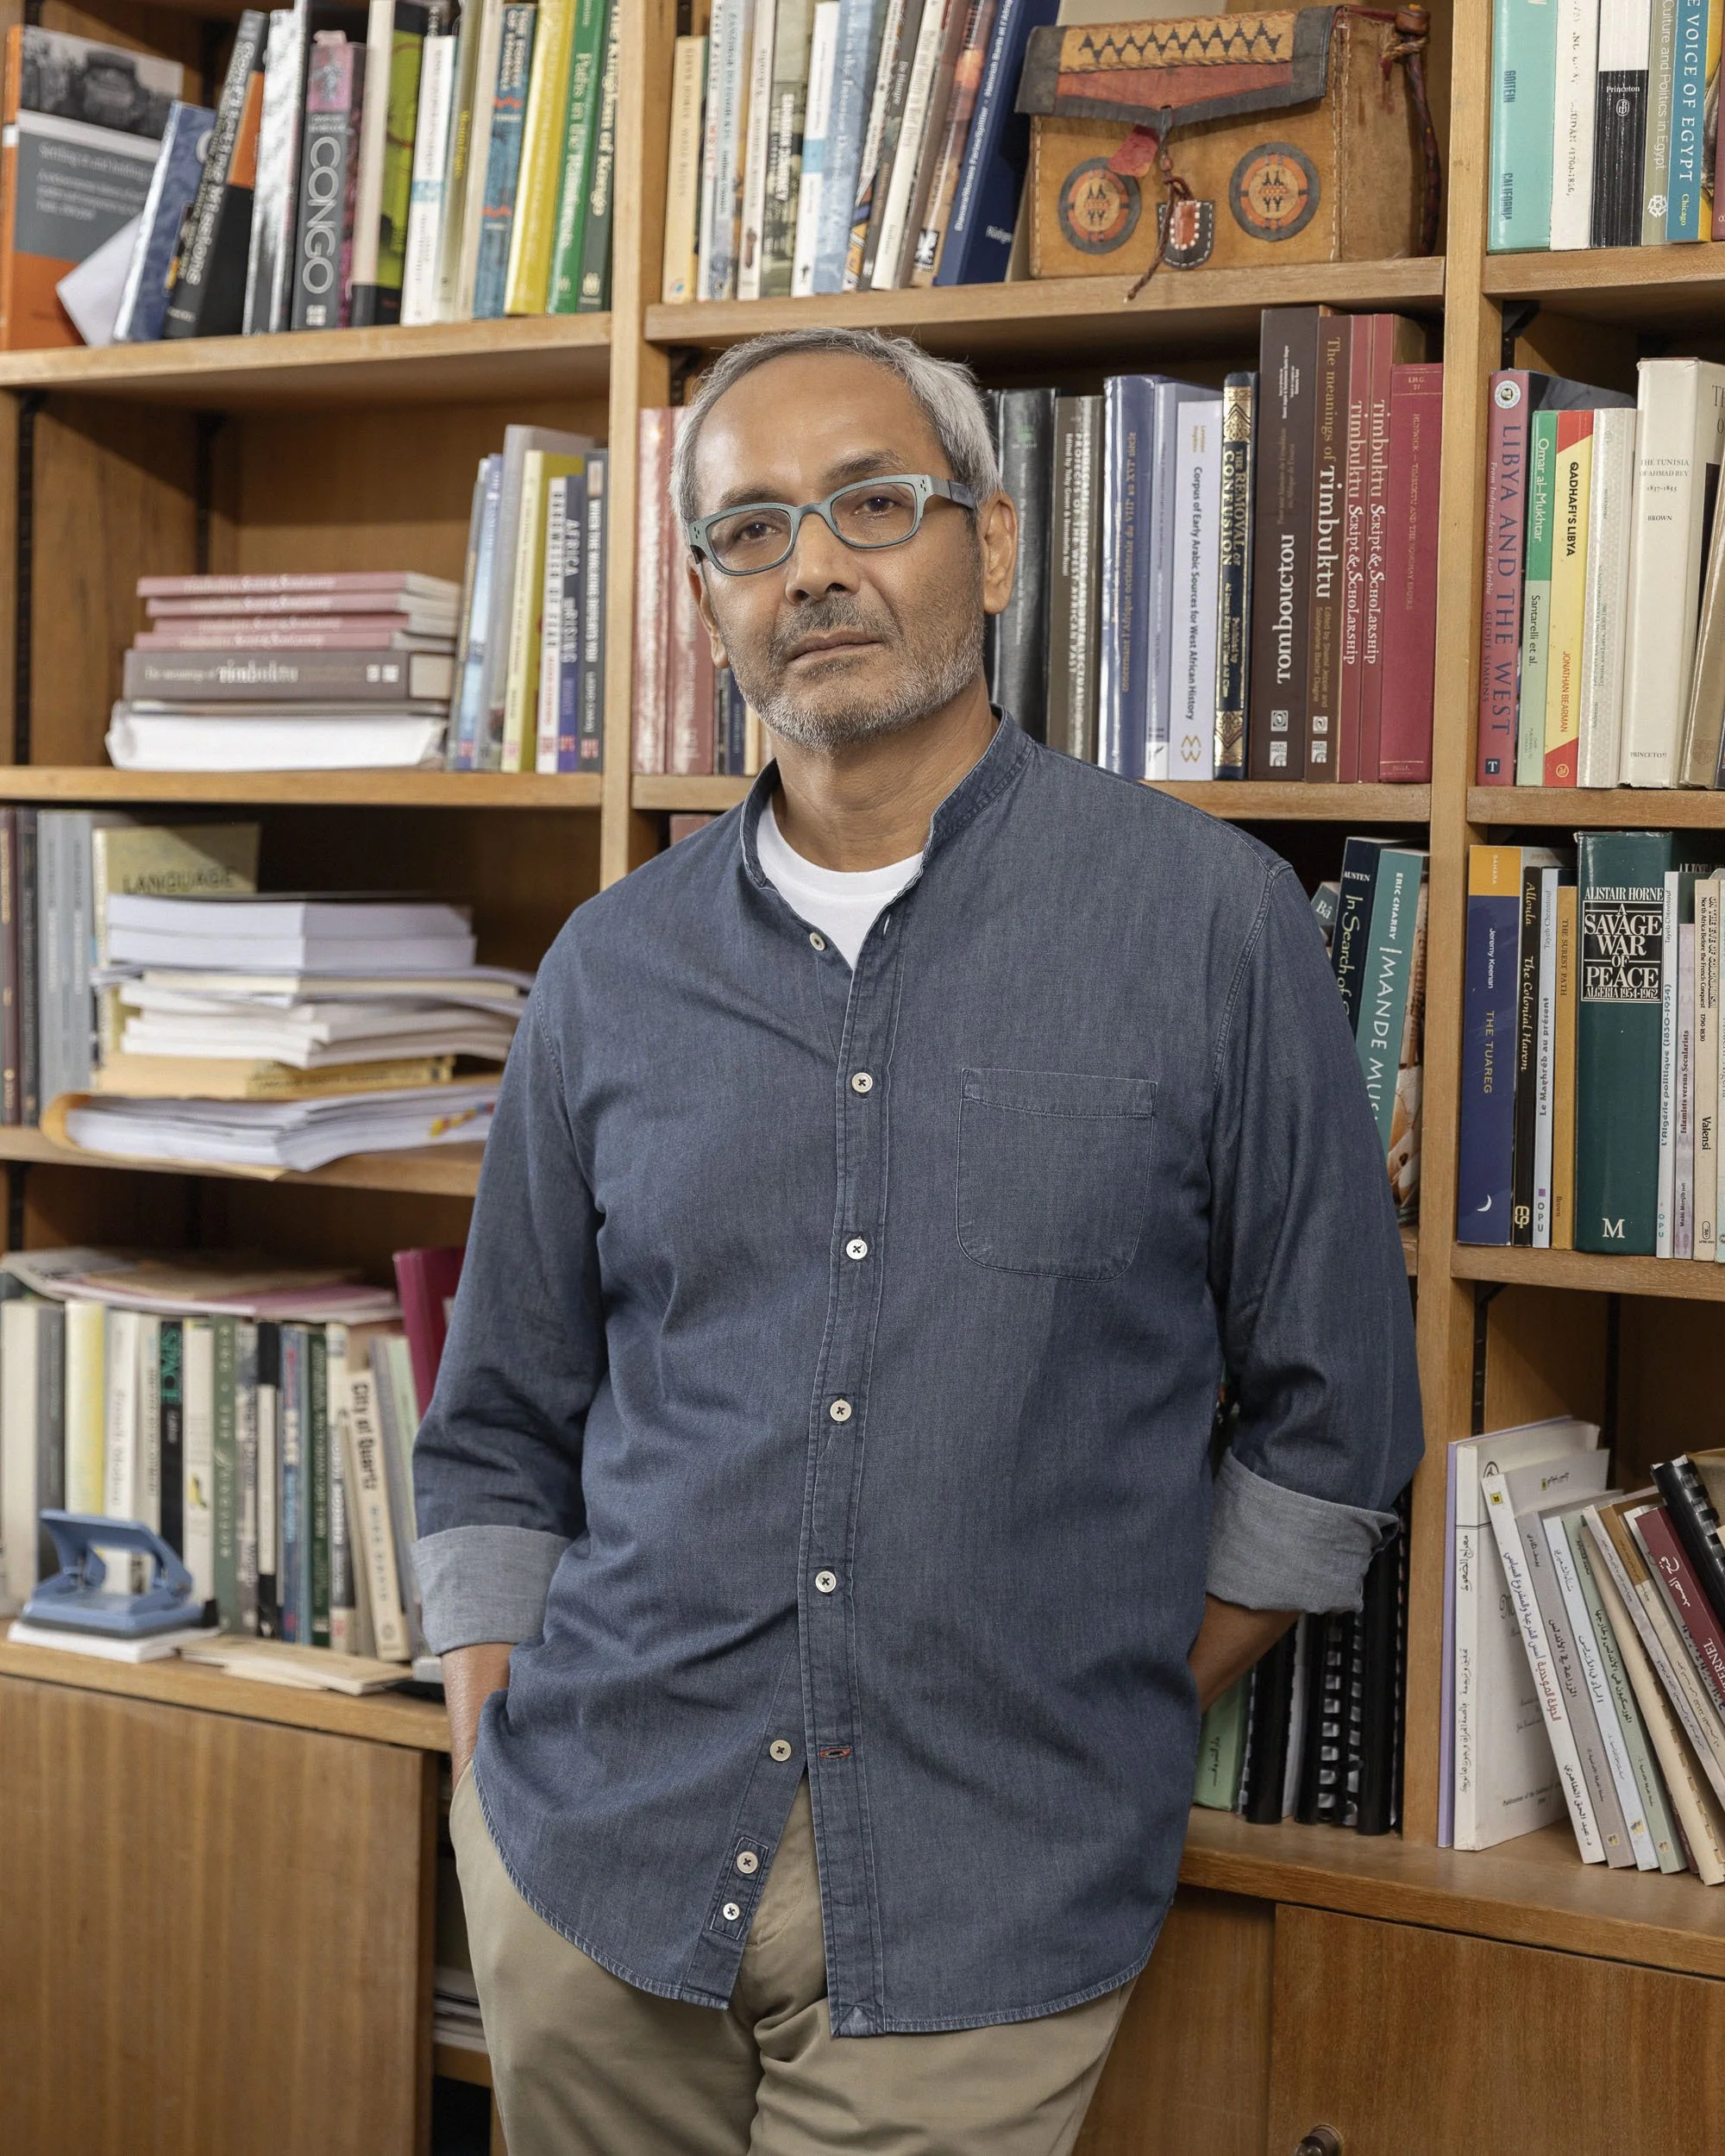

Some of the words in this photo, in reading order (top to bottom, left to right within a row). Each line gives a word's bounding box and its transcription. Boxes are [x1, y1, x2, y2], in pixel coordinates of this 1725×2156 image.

[1660, 0, 1675, 43] Culture
[1659, 47, 1671, 71] and
[1684, 15, 1700, 76] VOICE
[572, 52, 592, 97] Paths
[1503, 70, 1516, 103] GOITEIN
[1606, 85, 1640, 94] Princeton
[569, 102, 586, 120] in
[1658, 74, 1672, 117] Politics
[1682, 84, 1697, 109] OF
[1656, 120, 1669, 131] in
[1653, 135, 1668, 171] Egypt
[1679, 116, 1696, 182] EGYPT
[1500, 172, 1514, 221] CALIFORNIA
[1680, 193, 1690, 226] Chicago
[302, 136, 336, 295] CONGO
[183, 183, 223, 286] Missions
[1327, 336, 1340, 367] The
[1320, 371, 1338, 443] meanings
[1072, 432, 1082, 494] PROJECTS
[1234, 449, 1244, 469] THE
[1325, 448, 1337, 463] of
[1347, 400, 1369, 498] Timbuktu
[1370, 399, 1390, 498] Timbuktu
[1500, 425, 1521, 502] LIBYA
[1537, 438, 1550, 474] Omar
[1654, 458, 1690, 467] TUNISIA
[1193, 467, 1203, 499] Corpus
[1566, 461, 1579, 524] QADHAFI'S
[1072, 498, 1081, 515] OF
[1194, 501, 1201, 511] of
[1221, 450, 1235, 566] CONFUSION
[1233, 471, 1247, 546] REMOVAL
[1488, 486, 1496, 542] Independence
[1533, 475, 1548, 542] al-Mukhtar
[1071, 521, 1080, 545] THE
[1192, 513, 1201, 539] Early
[1315, 465, 1343, 599] Timbuktu
[1346, 505, 1364, 553] Script
[1368, 503, 1387, 553] Script
[1565, 524, 1578, 557] LIBYA
[565, 517, 580, 577] AFRICA
[1191, 540, 1201, 569] Arabic
[1346, 554, 1360, 570] &
[1367, 553, 1383, 570] &
[1497, 515, 1519, 577] AND
[1070, 548, 1079, 585] WEST
[1486, 556, 1495, 595] Lockerbie
[1190, 570, 1200, 610] Sources
[1069, 587, 1078, 640] AFRICAN
[1272, 533, 1295, 684] Tombouctou
[1343, 570, 1364, 665] Scholarship
[1364, 570, 1385, 664] Scholarship
[1495, 589, 1515, 645] THE
[1528, 595, 1540, 640] Santarelli
[1189, 624, 1198, 646] West
[1484, 611, 1492, 649] GEOFF
[1068, 643, 1077, 674] PAST
[1528, 656, 1538, 666] al.
[1529, 642, 1537, 653] et
[1189, 648, 1198, 683] African
[1482, 655, 1491, 702] SIMONS
[1561, 651, 1571, 693] JONATHAN
[1186, 686, 1197, 720] History
[1491, 661, 1513, 735] WEST
[1559, 694, 1569, 732] BEARMAN
[1488, 761, 1498, 772] T
[122, 868, 234, 894] LANGUAGE
[1343, 870, 1371, 882] AUSTEN
[1394, 872, 1403, 896] ERIC
[1315, 899, 1333, 919] Bâ
[1346, 893, 1364, 910] In
[1525, 881, 1536, 926] Alloula
[1585, 887, 1626, 901] ALISTAIR
[1628, 887, 1664, 901] HORNE
[1617, 903, 1628, 915] A
[1389, 898, 1401, 941] CHARRY
[1584, 914, 1663, 937] SAVAGE
[1339, 912, 1359, 975] Search
[1487, 928, 1496, 957] Jeremy
[1597, 935, 1647, 956] WAR
[1487, 958, 1496, 988] Keenan
[1524, 956, 1534, 980] The
[1586, 967, 1659, 988] PEACE
[1611, 955, 1630, 968] OF
[1338, 977, 1352, 998] of
[1585, 988, 1618, 999] ALGERIA
[1620, 988, 1659, 1000] 1954-1962
[1708, 956, 1716, 1009] COLONIALISM
[1371, 956, 1397, 1050] MANDE
[1521, 982, 1534, 1029] Colonial
[1485, 1011, 1495, 1037] THE
[1483, 1040, 1494, 1094] TUAREG
[1520, 1031, 1532, 1071] Harem
[1663, 1049, 1672, 1098] politique
[1540, 1106, 1546, 1116] Le
[1702, 1116, 1712, 1150] Valensi
[1602, 1218, 1626, 1238] M
[348, 1382, 372, 1415] City
[355, 1418, 373, 1435] of
[357, 1437, 381, 1491] Quartz
[1502, 1550, 1521, 1579] السياسي
[1509, 1577, 1530, 1614] والمشروع
[1668, 1576, 1690, 1608] الصمد
[1520, 1612, 1537, 1641] الشرعية
[1547, 1617, 1567, 1653] الأندلس
[1602, 1639, 1621, 1672] الأندلس
